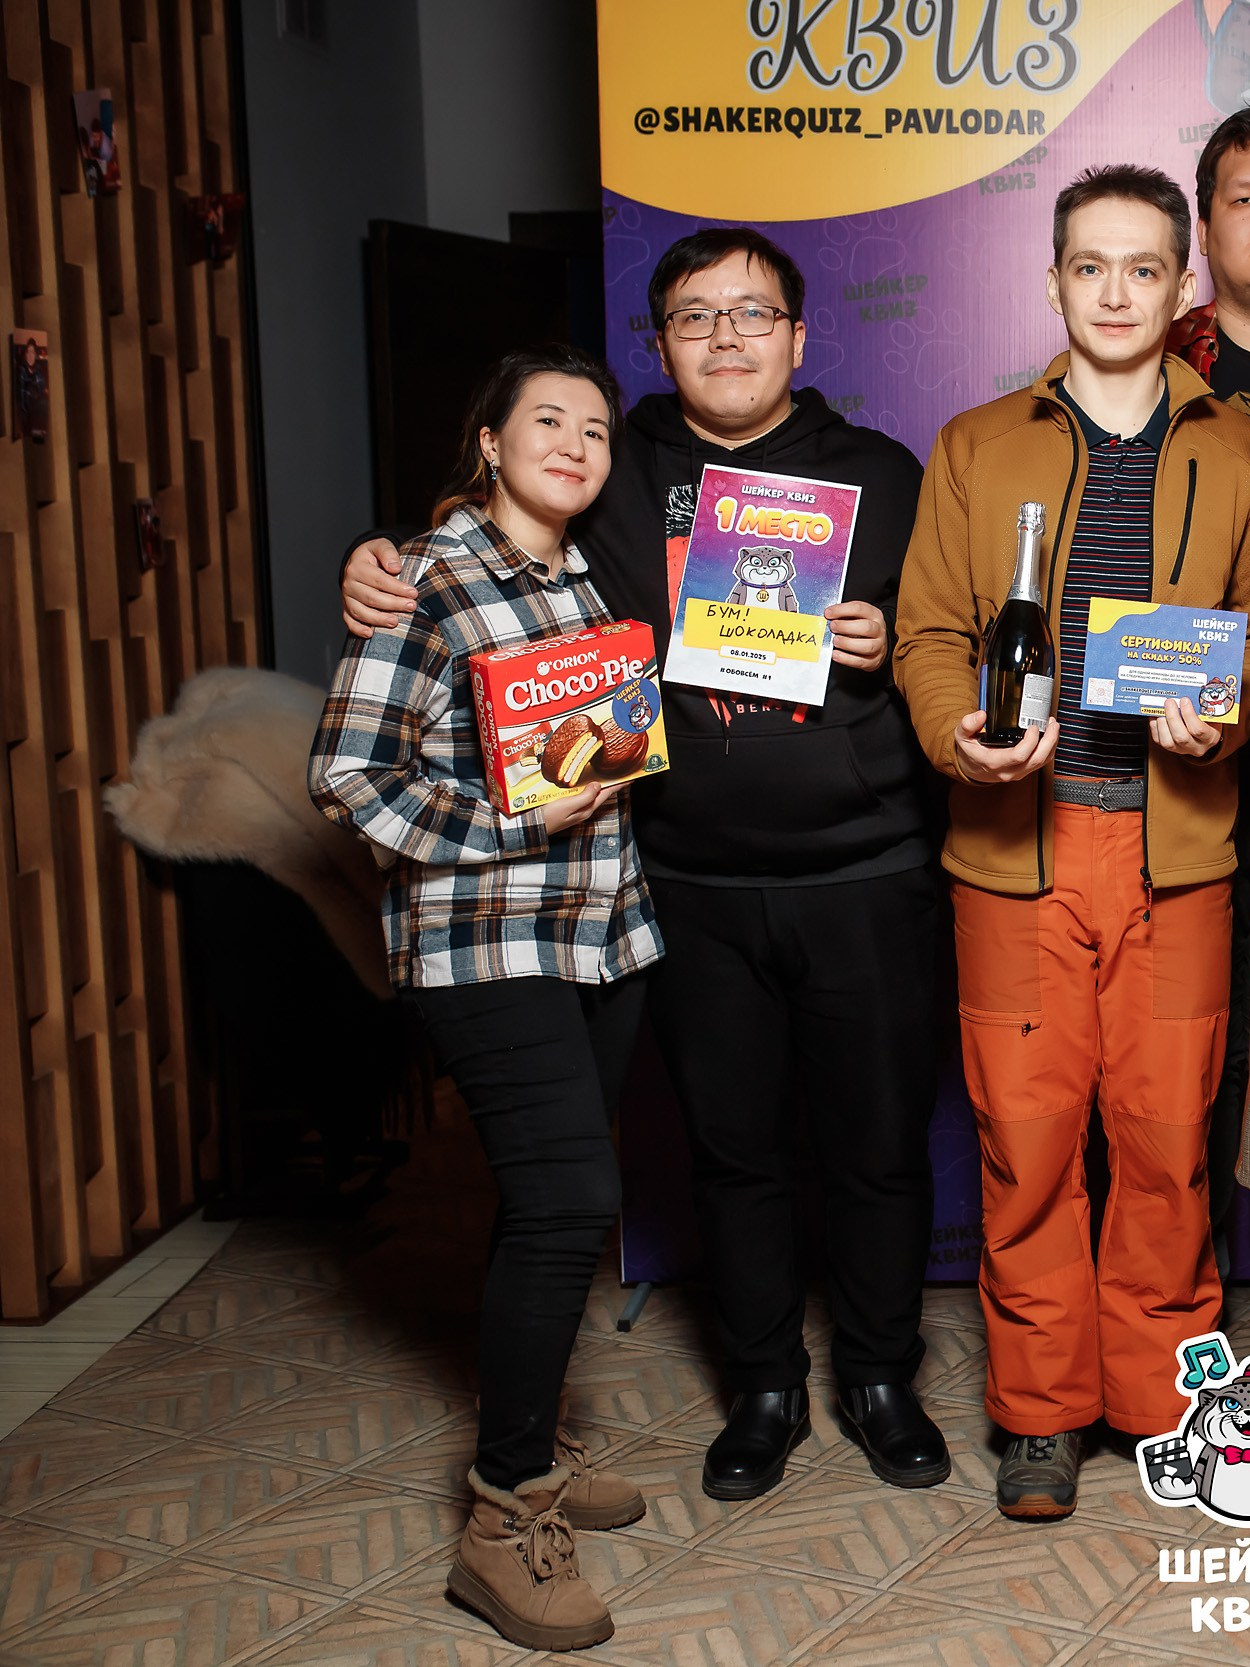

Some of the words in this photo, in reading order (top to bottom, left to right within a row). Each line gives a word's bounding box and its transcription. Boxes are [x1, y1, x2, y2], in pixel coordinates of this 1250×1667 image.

[633, 105, 1046, 139] @SHAKERQUIZ_PAVLODAR
[979, 172, 1037, 196] КВИЗ
[844, 275, 929, 302] ШЕЙКЕР
[860, 300, 918, 322] КВИЗ
[741, 485, 785, 498] ШЕЙКЕР
[787, 491, 816, 504] КВИЗ
[715, 497, 738, 531] 1
[738, 507, 831, 542] МЕСТО
[706, 604, 750, 621] БУМ!
[719, 624, 817, 646] ШОКОЛАДКА
[1192, 617, 1239, 632] ШЕЙКЕР
[1120, 635, 1211, 656] СЕРТИФИКАТ
[1198, 630, 1230, 642] КВИЗ
[552, 650, 598, 671] ORION
[730, 649, 767, 661] 08.01.2025
[1127, 651, 1139, 660] НА
[1141, 652, 1176, 664] СКИДКУ
[1178, 654, 1202, 667] 50%
[615, 679, 641, 701] ШЕЙКЕР
[623, 688, 641, 704] КВИЗ
[488, 712, 498, 750] ORION
[525, 793, 538, 804] 12
